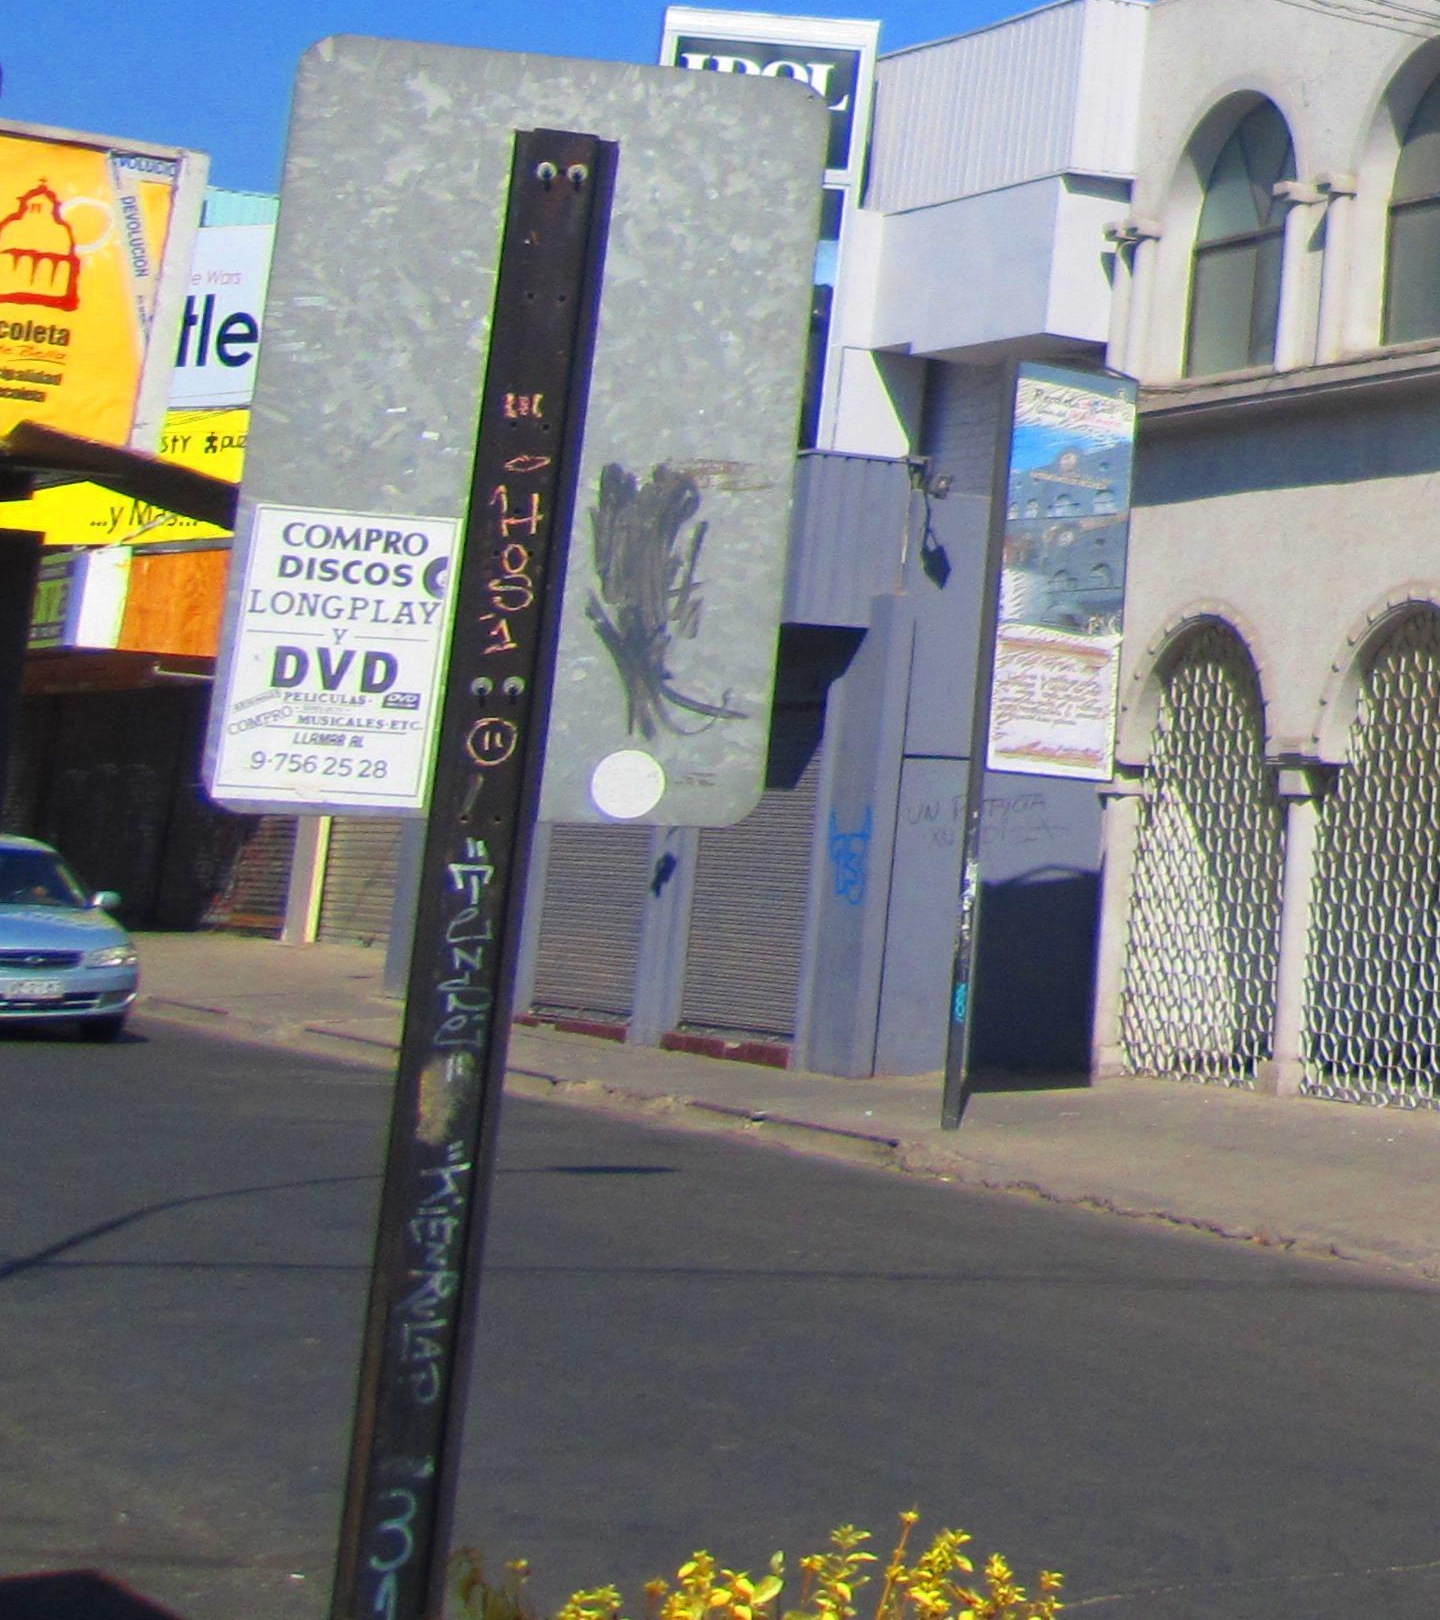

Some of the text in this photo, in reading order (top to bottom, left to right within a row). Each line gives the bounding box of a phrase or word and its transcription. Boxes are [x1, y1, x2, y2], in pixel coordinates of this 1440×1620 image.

[282, 522, 430, 556] COMPRO
[277, 554, 414, 588] DISCOS
[247, 589, 442, 625] LONGPLAY
[332, 628, 348, 646] Y
[269, 645, 399, 694] DVD
[227, 706, 294, 735] COMPRO
[322, 756, 353, 777] 25
[357, 759, 388, 779] 28
